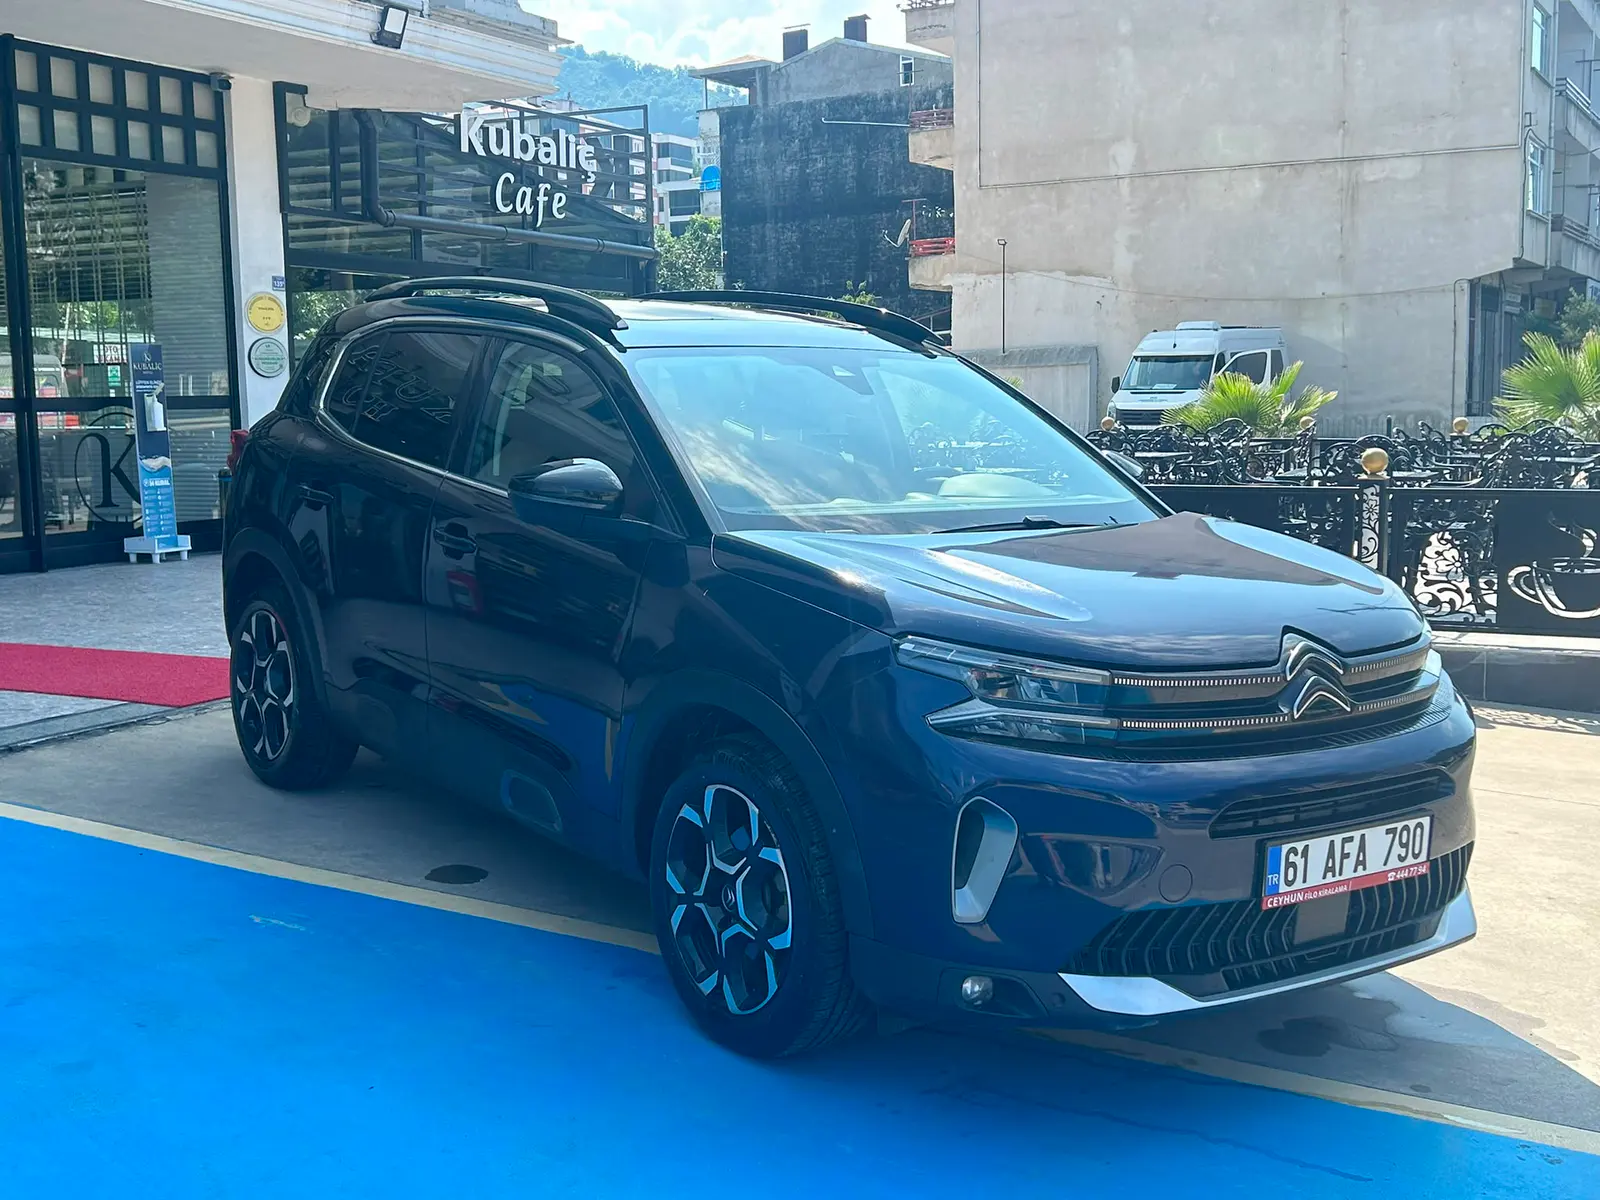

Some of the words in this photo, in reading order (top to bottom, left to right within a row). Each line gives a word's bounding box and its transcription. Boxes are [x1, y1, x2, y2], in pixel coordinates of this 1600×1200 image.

[460, 109, 597, 183] Kubaliç
[495, 172, 568, 228] Cafe
[1267, 873, 1279, 886] TR
[1283, 843, 1310, 887] 61
[1322, 833, 1367, 880] AFA
[1383, 821, 1425, 867] 790
[1267, 891, 1304, 908] CEYHUN
[1318, 885, 1348, 897] KİRALAMA
[1396, 868, 1408, 879] 444
